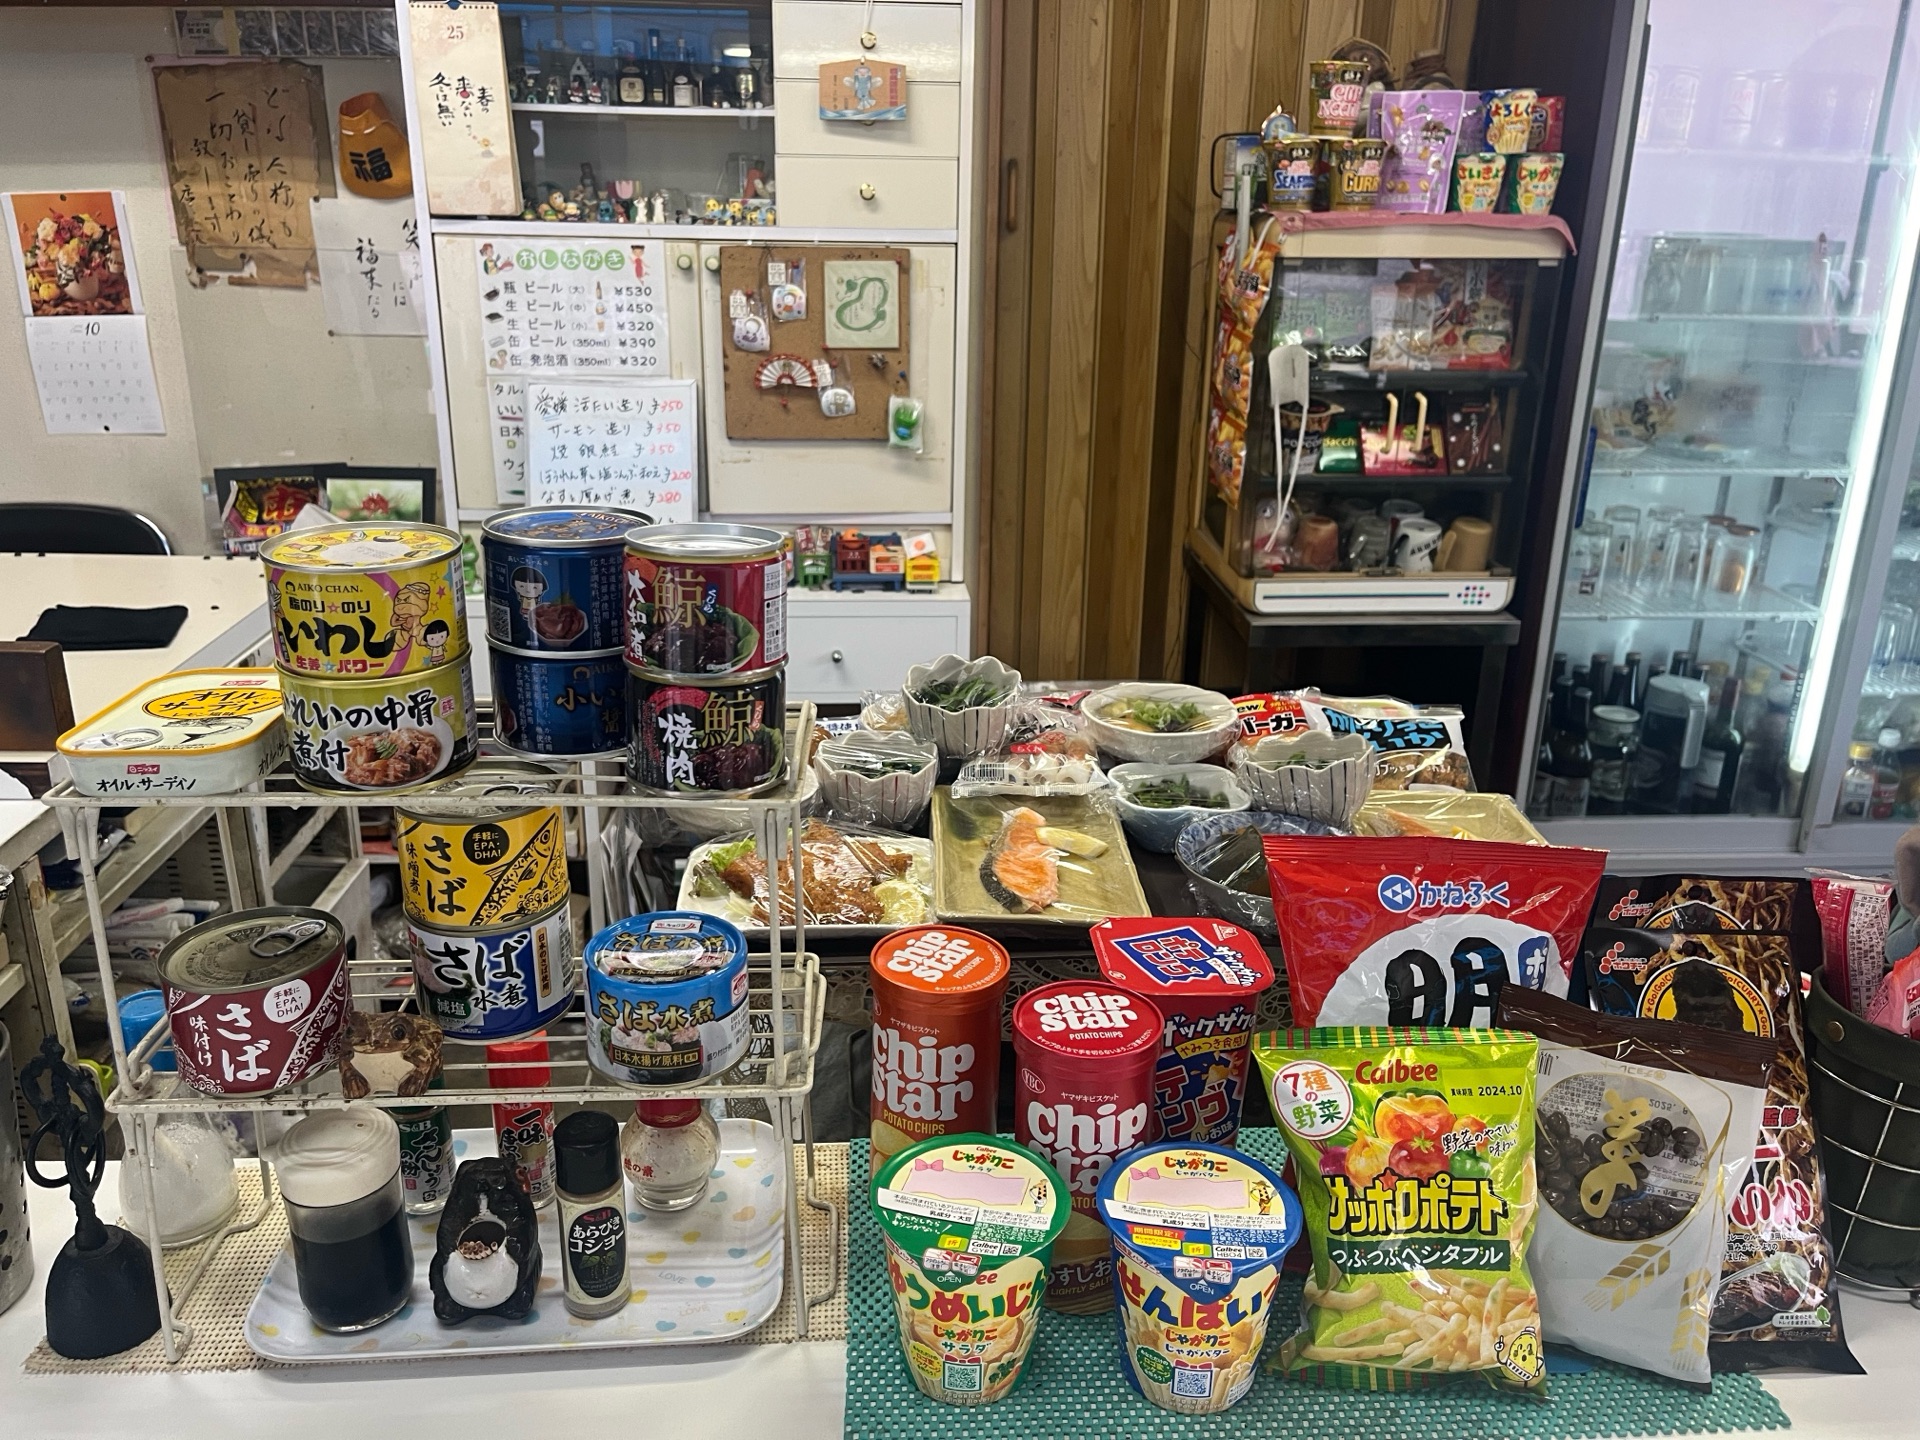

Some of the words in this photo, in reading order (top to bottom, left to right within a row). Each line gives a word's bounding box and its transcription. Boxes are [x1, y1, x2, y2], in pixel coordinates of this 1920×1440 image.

[446, 25, 464, 41] 25
[349, 147, 393, 184] 福
[515, 248, 626, 271] おしながき
[503, 281, 517, 295] 瓶
[525, 281, 563, 294] ビール
[613, 285, 653, 297] ¥530
[505, 300, 518, 312] 生
[526, 299, 565, 312] ビール
[615, 302, 654, 314] ¥450
[85, 322, 101, 336] 10
[506, 319, 519, 331] 生
[528, 319, 566, 331] ビール
[616, 320, 655, 332] ¥320
[508, 336, 521, 348] 缶
[529, 335, 567, 348] ビール
[618, 337, 656, 348] ¥390
[509, 354, 522, 366] 缶
[530, 353, 569, 367] 発泡酒
[619, 355, 657, 367] ¥320
[548, 425, 597, 439] サーモン
[297, 582, 323, 594] AIKO
[325, 584, 360, 594] CHAN
[650, 565, 707, 629] 鯨
[341, 599, 371, 614] のり
[626, 568, 648, 662] 大和煮
[281, 615, 397, 660] いわし
[295, 655, 321, 672] 生姜
[336, 658, 385, 673] パワー
[701, 689, 755, 748] 鯨
[292, 729, 351, 771] 煮付
[657, 711, 699, 786] 焼肉
[136, 765, 160, 773] ニッスイ
[472, 831, 499, 842] 手軽に
[405, 842, 421, 897] 味噌煮
[423, 835, 468, 917] さば
[1419, 880, 1511, 909] かねふく
[425, 933, 531, 987] さば
[273, 986, 301, 1000] 手軽に
[471, 983, 528, 1013] 水煮
[437, 998, 467, 1017] 減塩
[597, 990, 716, 1032] さば水煮
[189, 1014, 213, 1068] 味付け
[216, 1003, 272, 1082] さば
[1069, 1032, 1100, 1041] POTATO
[1100, 1030, 1124, 1040] CHIPS
[1023, 1070, 1044, 1091] YBC
[1355, 1058, 1439, 1085] Calbee
[1281, 1067, 1333, 1097] 7種
[1477, 1085, 1523, 1097] 2024.10
[1060, 1091, 1120, 1103] ヤマザキビスケット
[1305, 1090, 1318, 1103] の
[883, 1109, 914, 1133] POTATO
[914, 1121, 945, 1135] CHIPS
[1291, 1099, 1344, 1130] 野菜
[1762, 1107, 1799, 1127] 監修
[399, 1120, 432, 1133] S&B
[512, 1108, 546, 1146] 一味
[1195, 1122, 1234, 1143] しお味
[1442, 1122, 1520, 1155] 野菜のやさしい
[1488, 1137, 1517, 1158] 味わい
[411, 1127, 444, 1189] さんしょう
[975, 1145, 998, 1153] Calbee
[1185, 1150, 1207, 1158] Calbee
[951, 1148, 1016, 1170] じゃがりこ
[1163, 1155, 1229, 1173] じゃがりこ
[1174, 1169, 1221, 1179] じゃがバター
[1322, 1173, 1508, 1235] サッポロポテト
[582, 1208, 613, 1224] S&B
[572, 1214, 621, 1240] あらびき
[971, 1240, 1000, 1250] Calbee
[1214, 1246, 1244, 1254] Calbee
[1331, 1242, 1505, 1268] つぶつぶベジタブル
[657, 1270, 688, 1285] LOVE
[936, 1275, 962, 1284] OPEN
[1051, 1284, 1088, 1297] LIGHTLY
[1189, 1283, 1216, 1296] OPEN
[932, 1323, 998, 1343] じゃがりこ
[1164, 1327, 1232, 1348] じゃがりこ
[940, 1341, 992, 1356] サラダ
[1164, 1342, 1231, 1358] じゃがバター
